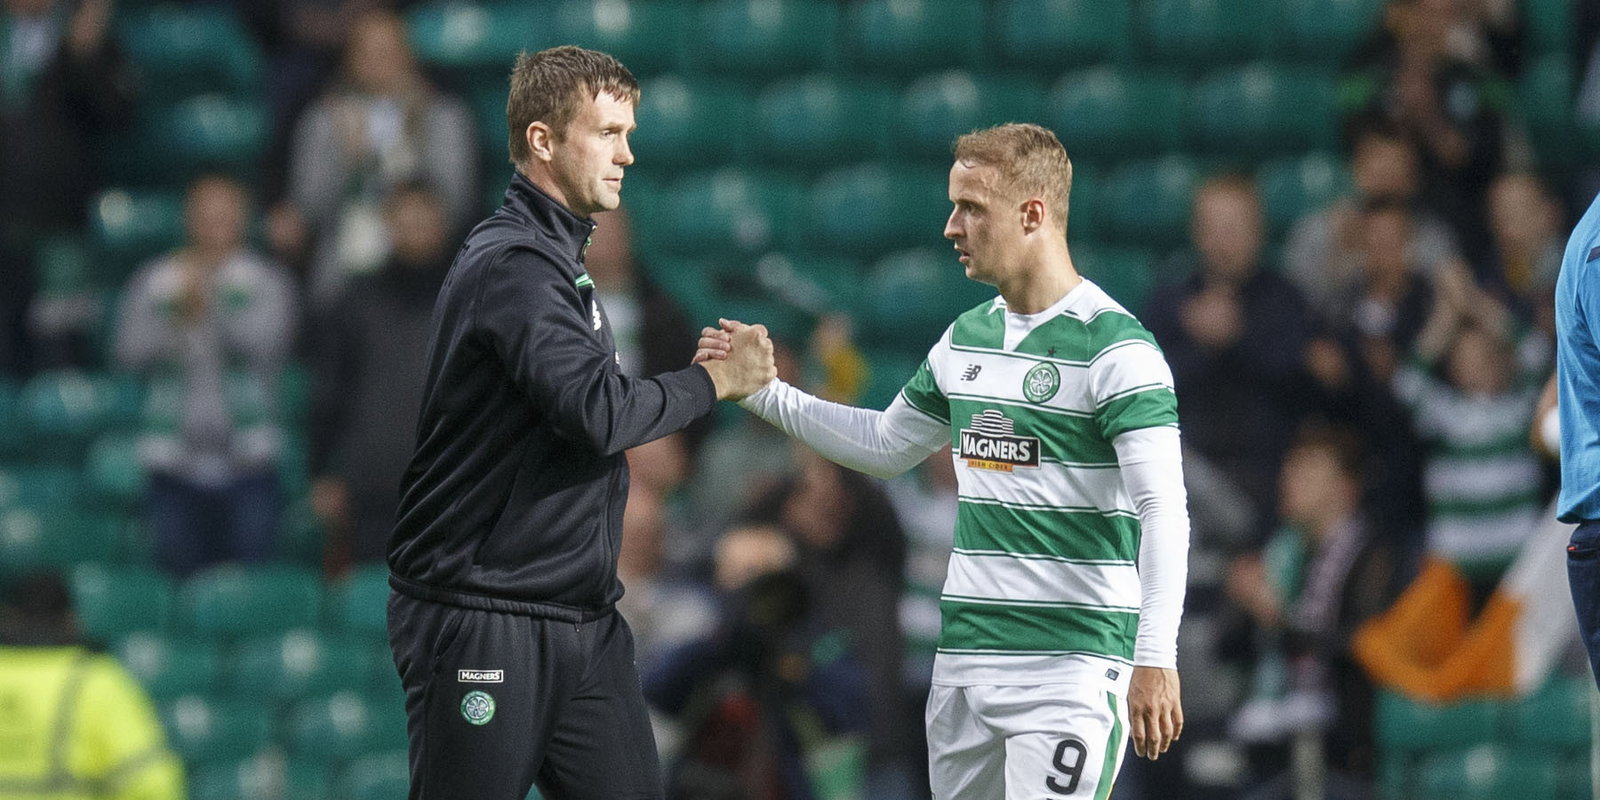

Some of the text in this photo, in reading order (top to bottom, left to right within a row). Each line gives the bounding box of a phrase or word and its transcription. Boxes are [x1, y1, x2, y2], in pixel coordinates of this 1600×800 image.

[962, 432, 1031, 462] MAGNERS
[461, 671, 501, 680] MAGNERS
[1046, 738, 1088, 796] 9
